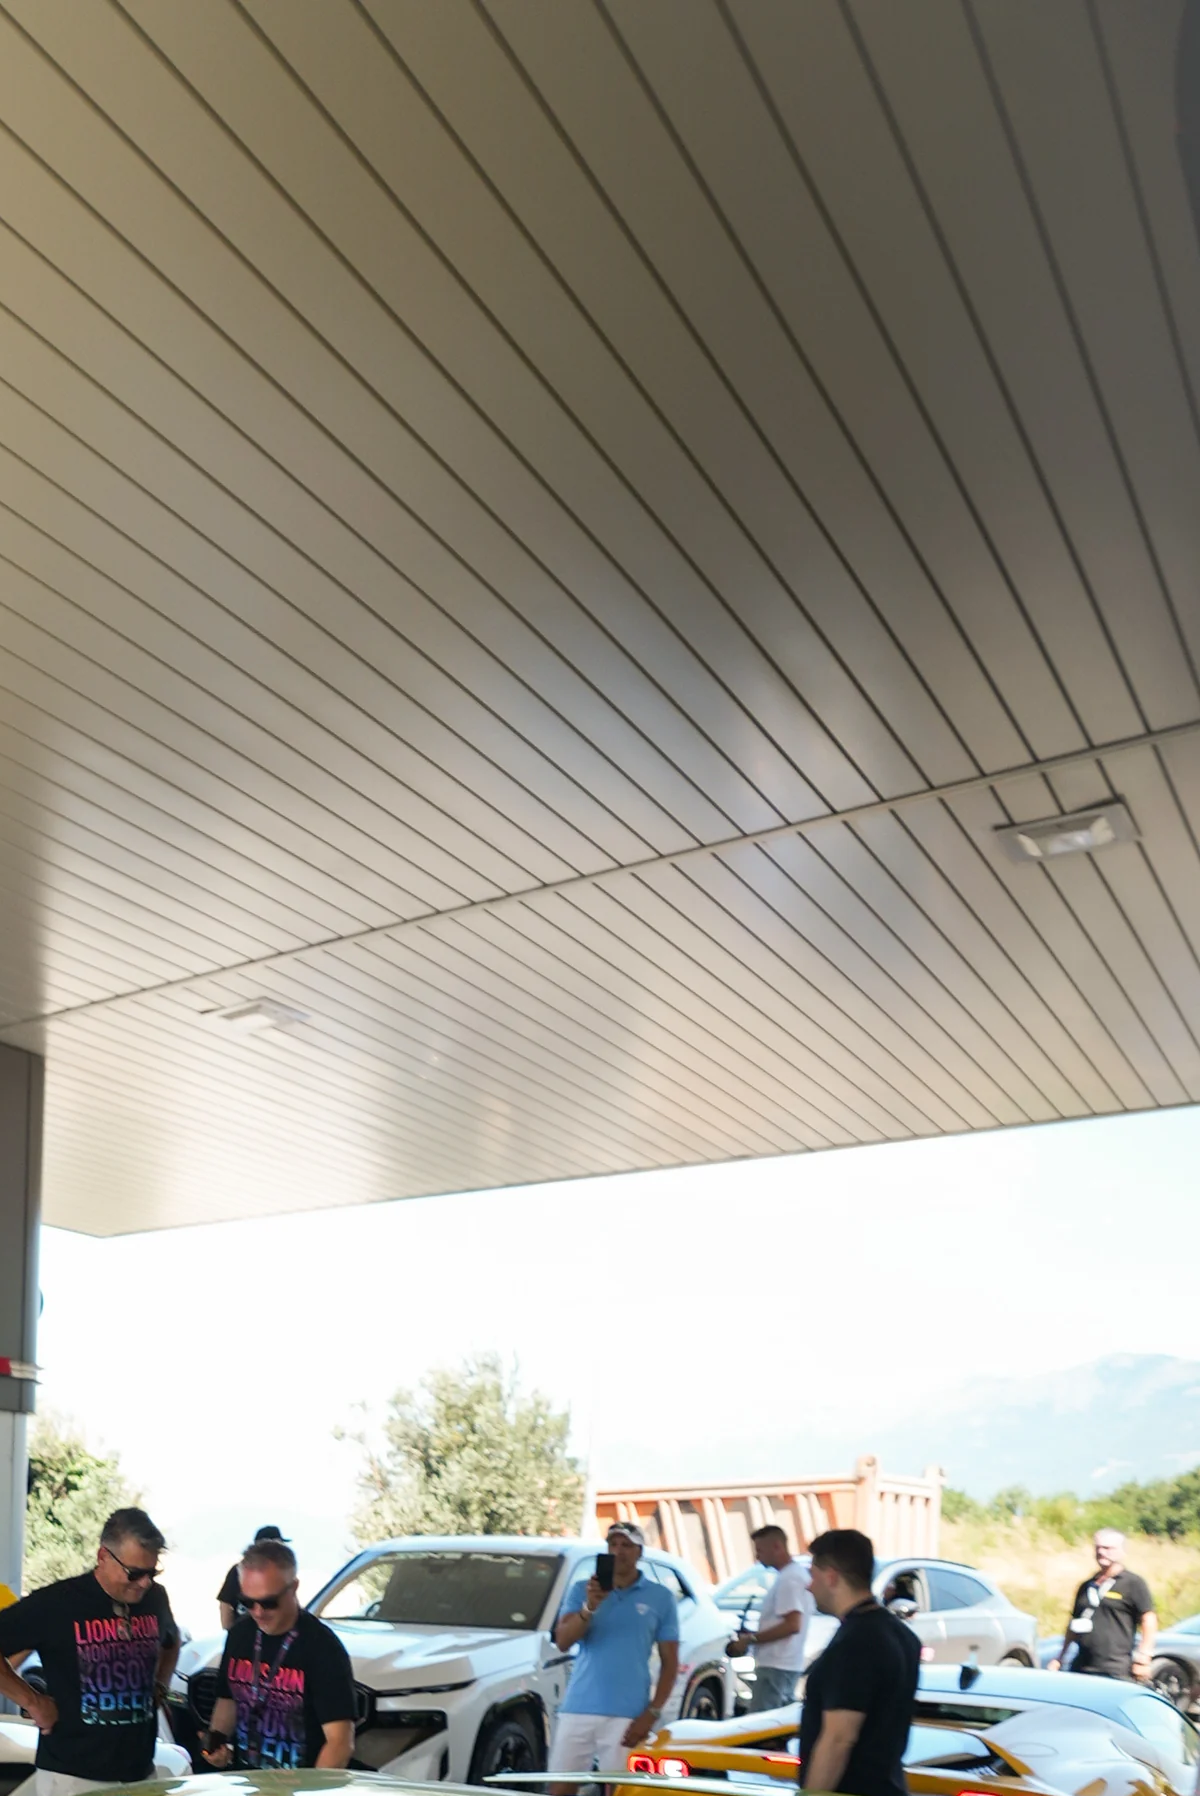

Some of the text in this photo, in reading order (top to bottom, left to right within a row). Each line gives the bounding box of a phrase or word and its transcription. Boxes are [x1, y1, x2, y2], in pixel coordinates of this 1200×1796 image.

[130, 1614, 159, 1640] RUN
[79, 1660, 153, 1694] KOSOV
[81, 1691, 153, 1726] GREE
